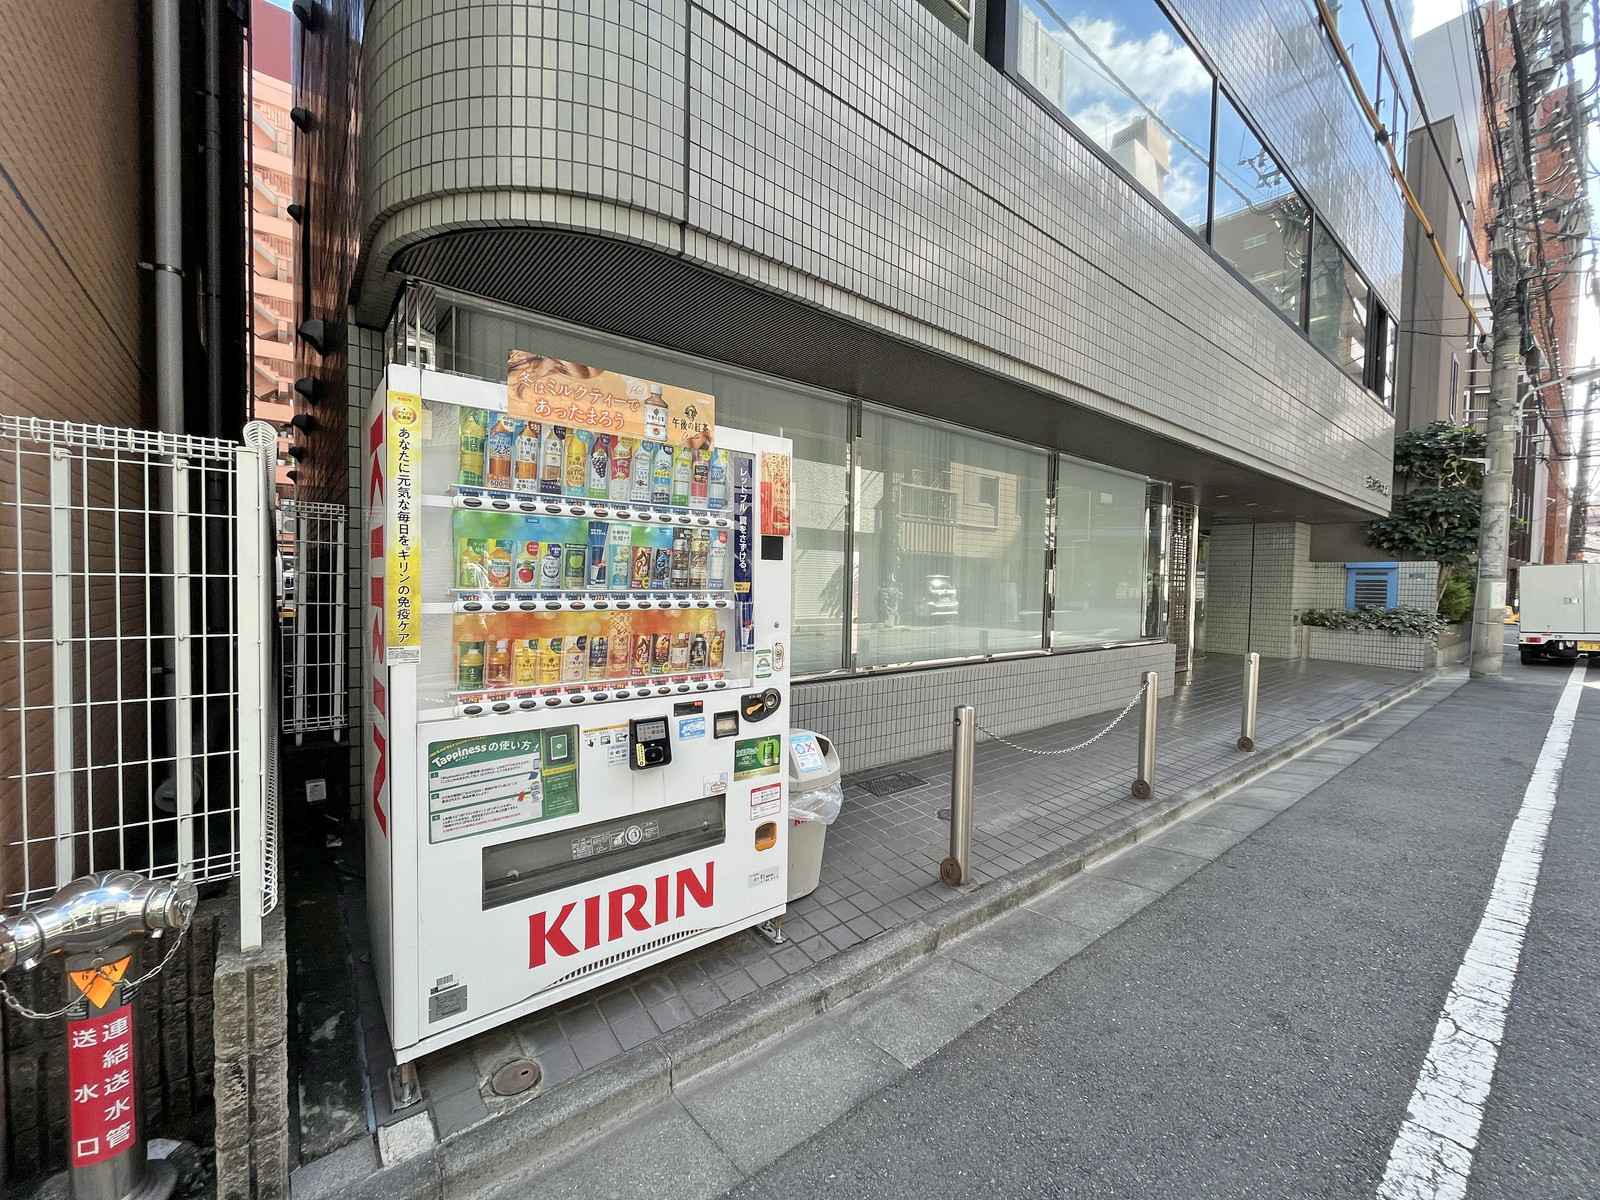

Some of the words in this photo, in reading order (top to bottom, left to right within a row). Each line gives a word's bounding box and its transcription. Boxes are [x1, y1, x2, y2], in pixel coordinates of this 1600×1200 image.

[517, 371, 641, 412] 冬はミルクティーで
[535, 399, 626, 431] あったまろう
[672, 416, 710, 433] 午後の紅茶
[493, 444, 511, 456] 麦茶
[739, 467, 748, 513] レッドブル
[397, 427, 412, 643] あなたに元気な毎日を。キリンの免疫ケア
[370, 409, 387, 839] KIRIN
[432, 743, 488, 768] Tappiness
[528, 861, 715, 970] KIRIN
[72, 1028, 100, 1158] 送水口
[102, 1014, 131, 1149] 連結送水管
